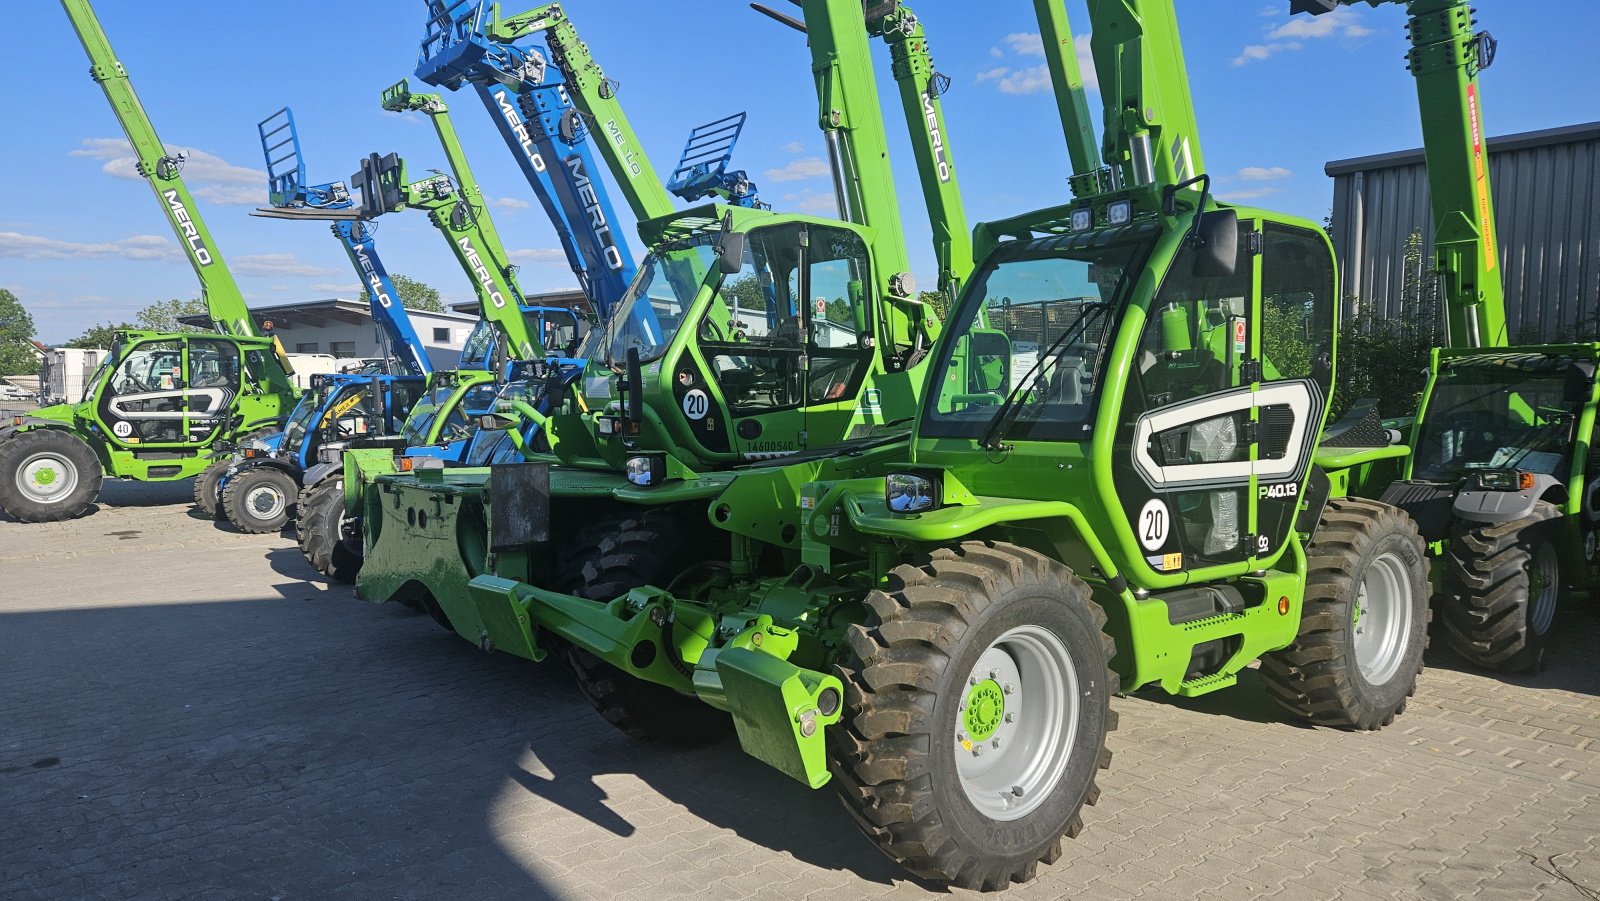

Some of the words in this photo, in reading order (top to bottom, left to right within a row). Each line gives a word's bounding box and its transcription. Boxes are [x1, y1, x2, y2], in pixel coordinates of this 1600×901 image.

[493, 90, 546, 173] MERLO
[607, 118, 641, 177] MELO
[922, 93, 949, 181] MERLO
[164, 189, 212, 266] MERLO
[566, 157, 623, 270] MERLO
[353, 243, 392, 308] MERLO
[458, 236, 506, 309] MERLO
[117, 424, 129, 434] 40
[687, 394, 705, 415] 20
[1258, 482, 1298, 500] P40.13
[1145, 508, 1163, 541] 20
